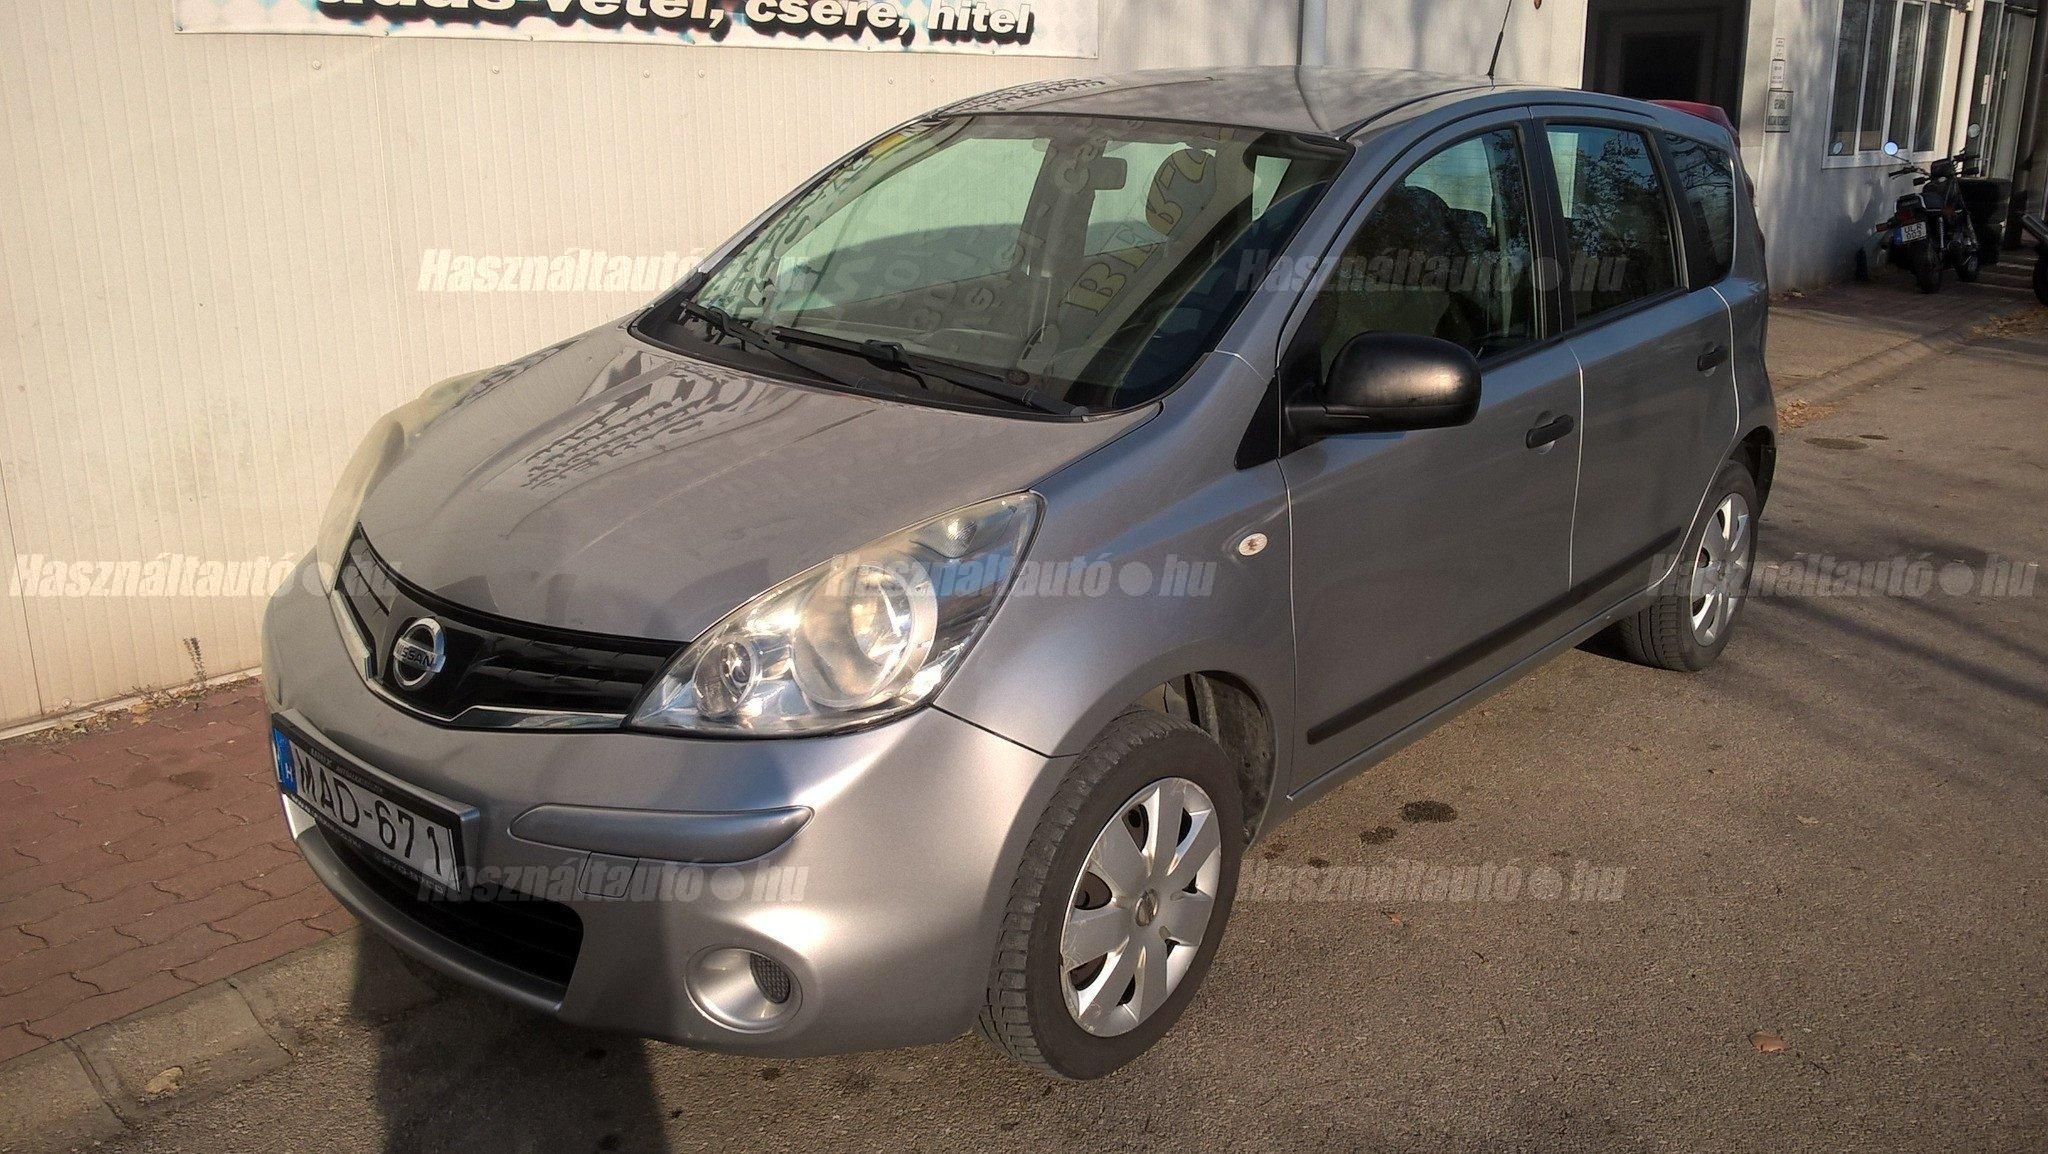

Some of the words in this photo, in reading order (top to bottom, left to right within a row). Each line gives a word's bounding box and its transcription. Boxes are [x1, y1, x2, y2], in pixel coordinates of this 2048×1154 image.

[744, 0, 911, 36] csere,
[927, 1, 1031, 35] hitel
[295, 748, 441, 876] MAD-671
